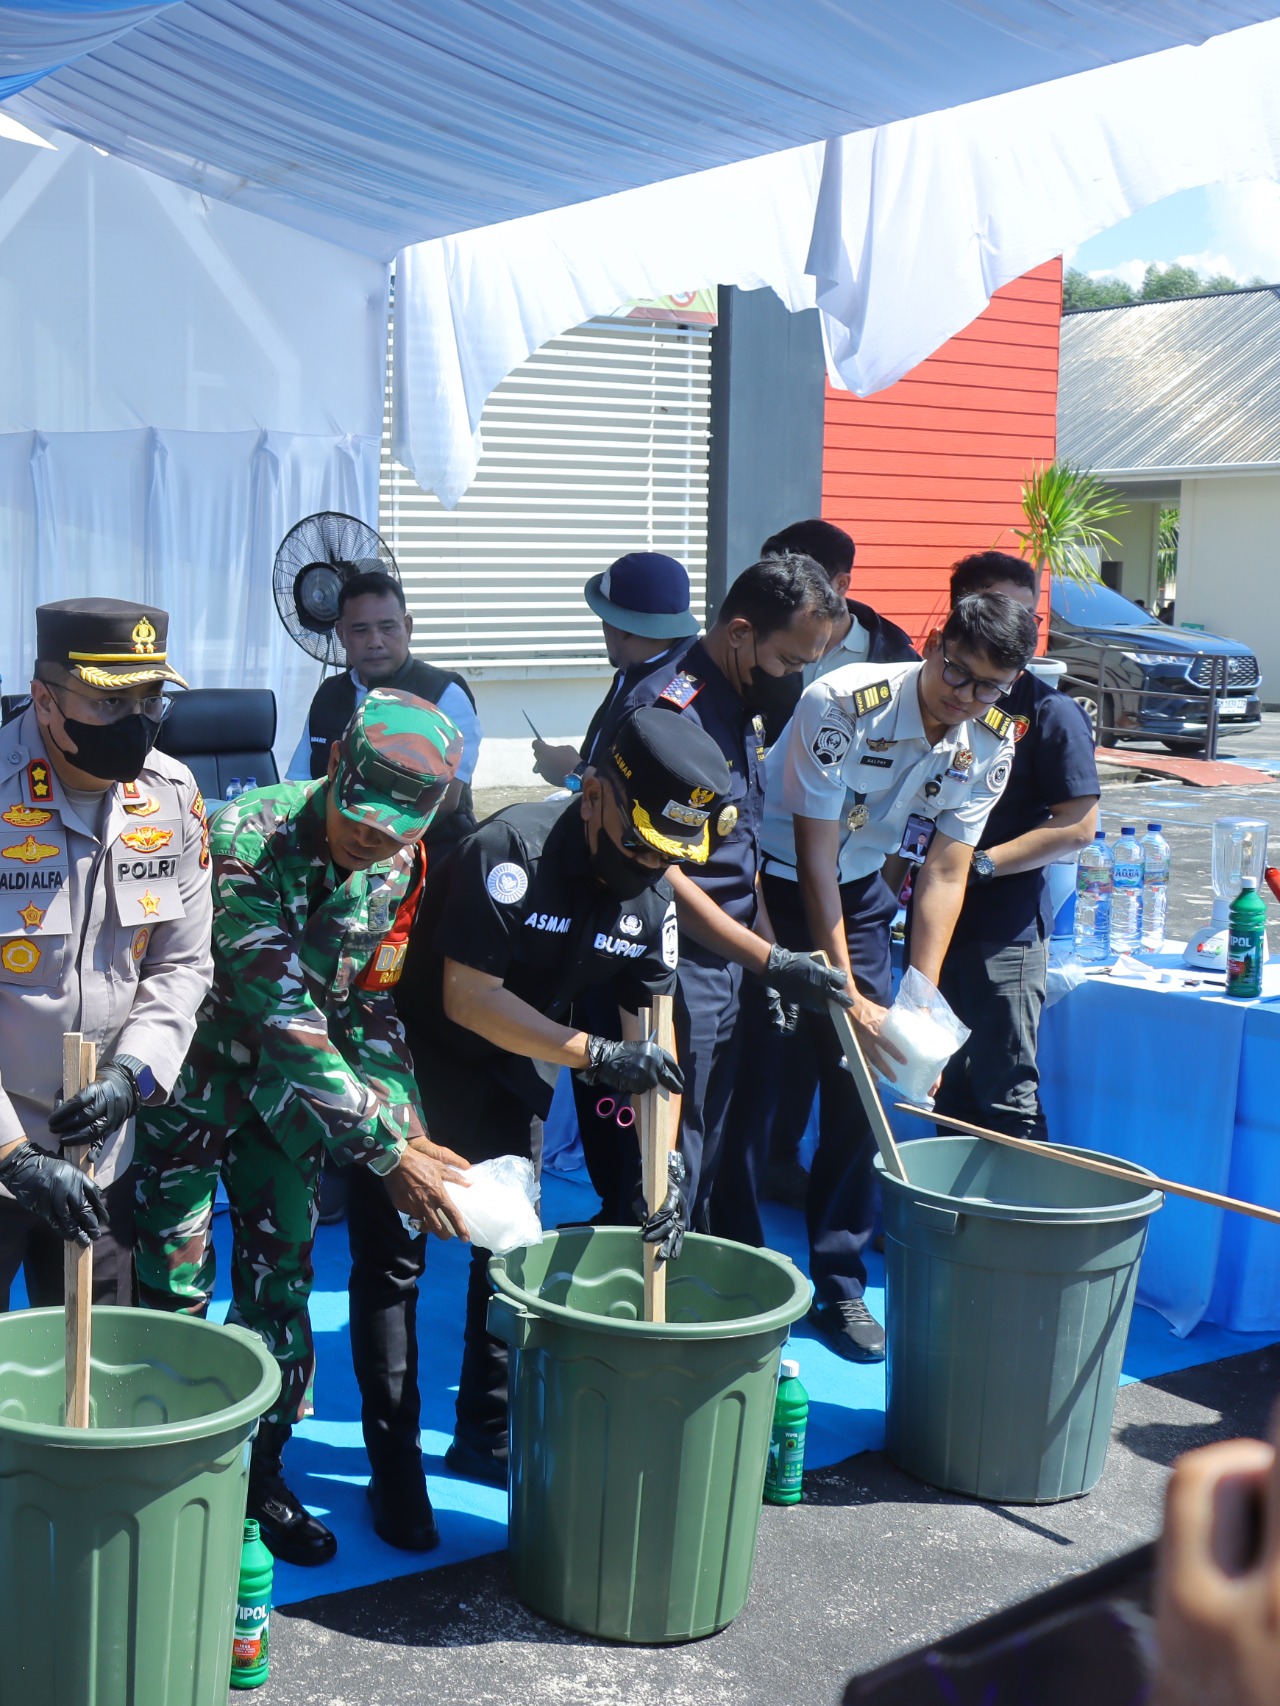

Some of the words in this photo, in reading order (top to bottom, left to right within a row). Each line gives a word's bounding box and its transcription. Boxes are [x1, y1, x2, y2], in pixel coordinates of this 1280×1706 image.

[615, 755, 632, 779] ASMAR
[118, 860, 176, 881] POLRI
[1115, 868, 1139, 879] AQUA
[594, 933, 647, 958] BUPATI
[1230, 936, 1251, 947] IPOL
